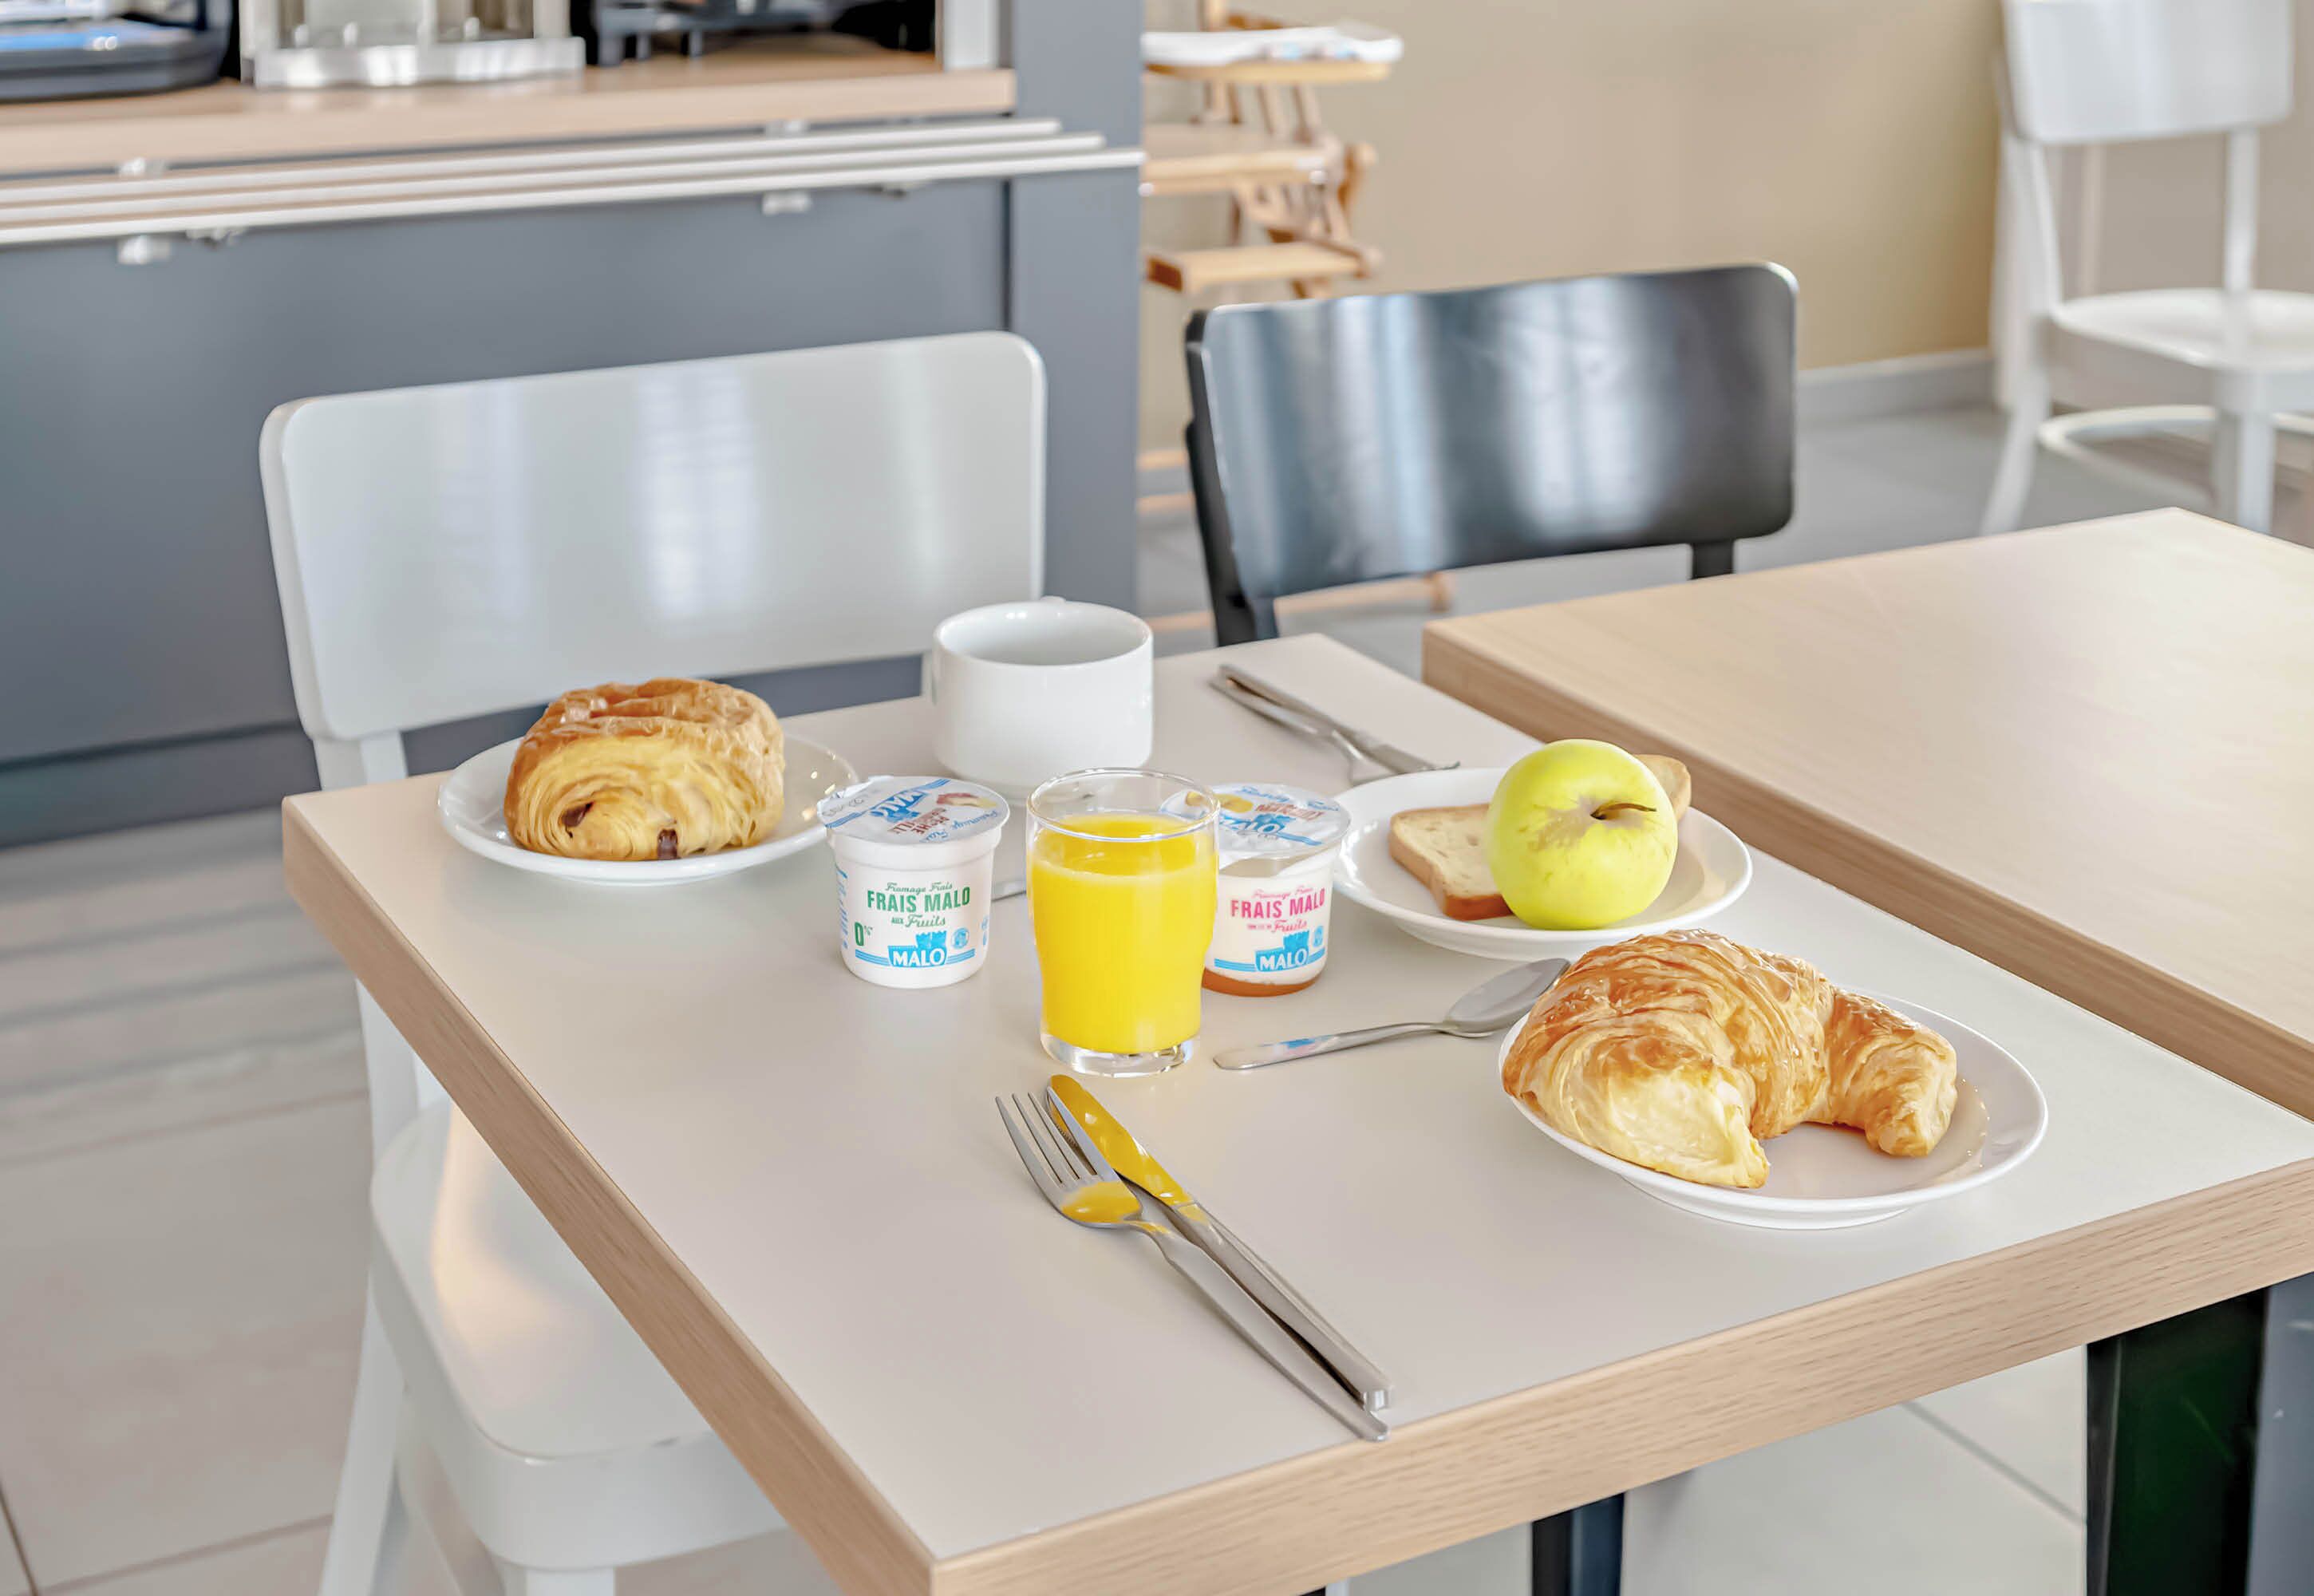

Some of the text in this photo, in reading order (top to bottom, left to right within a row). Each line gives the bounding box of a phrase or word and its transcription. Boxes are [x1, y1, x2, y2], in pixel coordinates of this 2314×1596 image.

[885, 882, 953, 895] Fromage Frais
[867, 887, 970, 913] FRAIS MALO
[1230, 888, 1325, 918] FRAIS MALO
[905, 914, 946, 927] Fruits
[1271, 919, 1308, 933] Fruits
[892, 948, 946, 966] MALO
[1259, 948, 1307, 970] MALO
